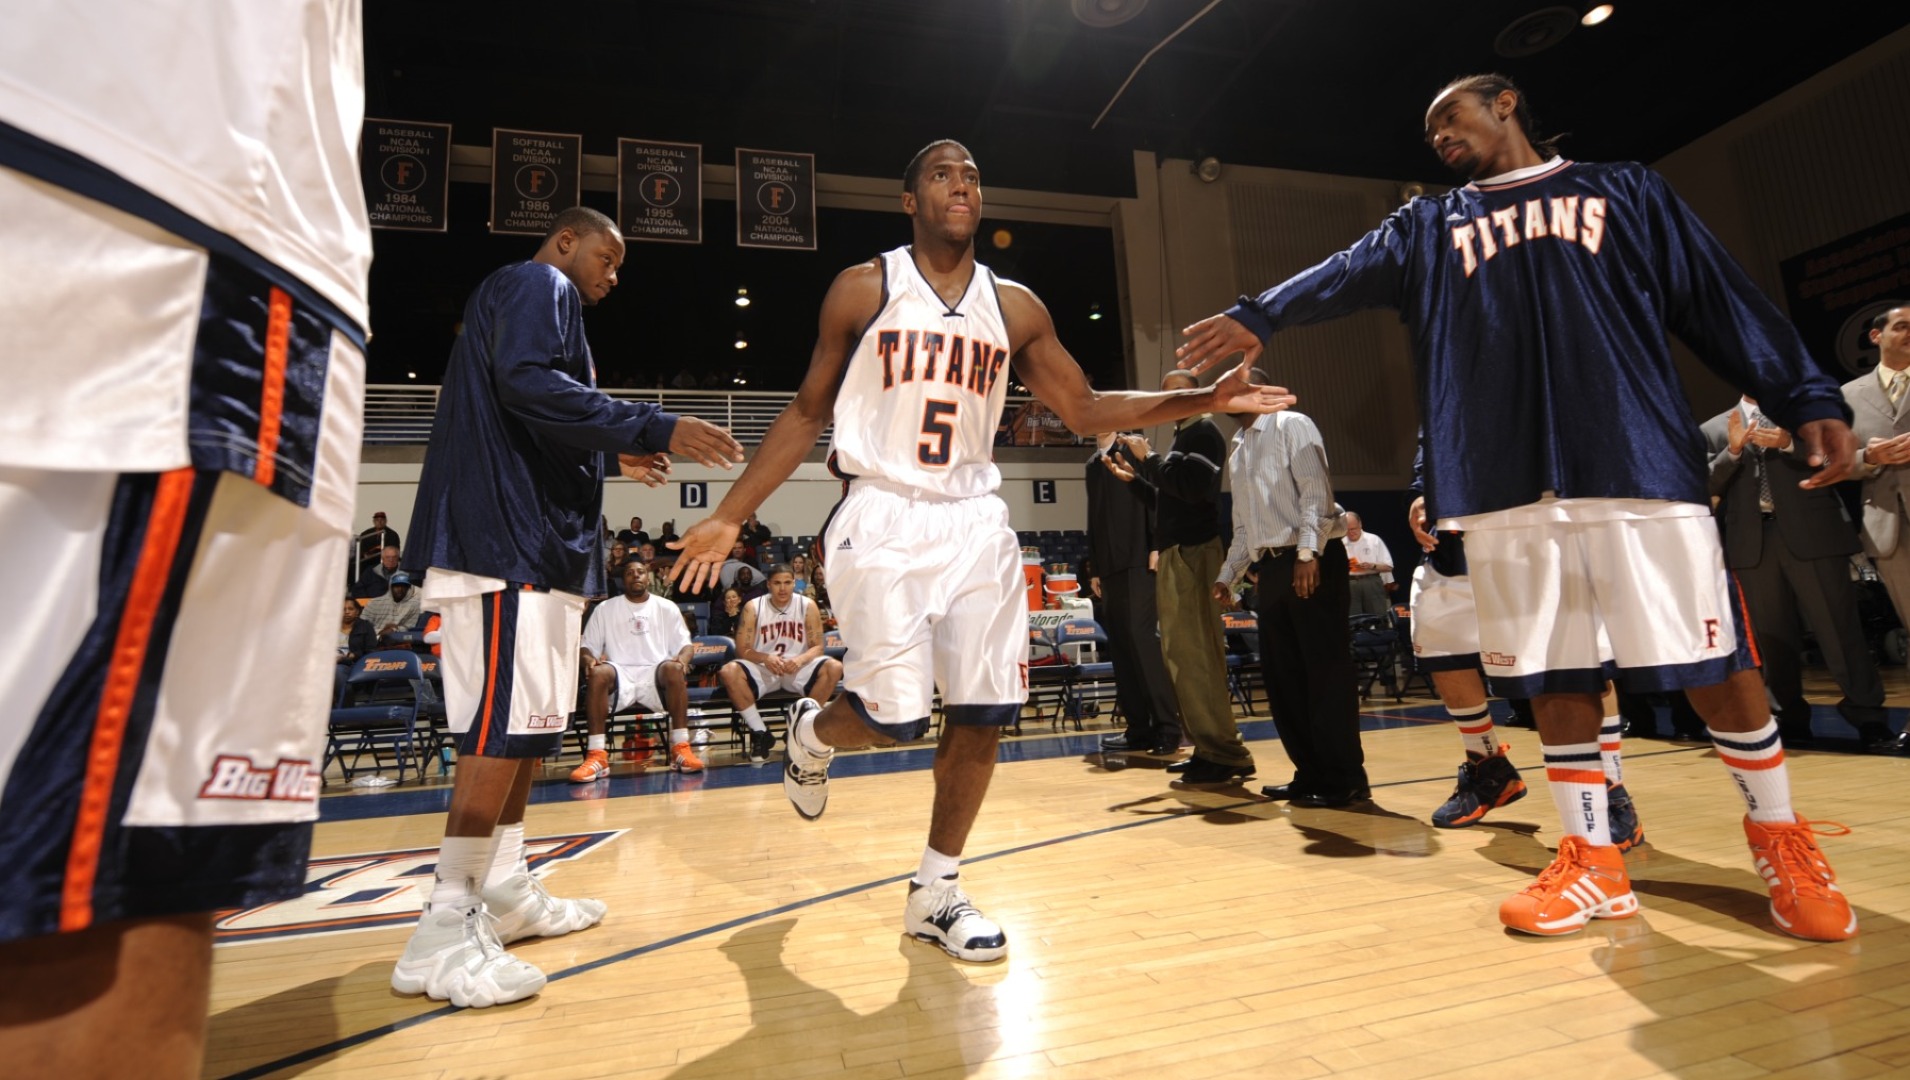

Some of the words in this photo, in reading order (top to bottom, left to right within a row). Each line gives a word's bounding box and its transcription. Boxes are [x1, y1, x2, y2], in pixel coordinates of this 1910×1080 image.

[378, 128, 434, 139] BASEBALL
[390, 138, 420, 147] NCAA
[512, 138, 564, 149] SOFTBALL
[379, 145, 424, 154] DIVISION
[523, 148, 552, 157] NCAA
[636, 147, 686, 158] BASEBALL
[512, 154, 555, 164] DIVISION
[646, 157, 674, 165] NCAA
[752, 157, 800, 168] BASEBALL
[397, 162, 413, 185] F
[637, 164, 678, 172] DIVISION
[763, 166, 788, 174] NCAA
[530, 170, 546, 192] F
[754, 172, 793, 182] DIVISION
[654, 179, 669, 200] F
[385, 193, 416, 204] 1984
[770, 187, 784, 208] F
[376, 203, 428, 214] NATIONAL
[520, 200, 550, 211] 1986
[370, 212, 432, 224] CHAMPIONS
[645, 208, 674, 218] 1995
[505, 219, 551, 229] CHAMPIO
[636, 217, 684, 228] NATIONAL
[762, 215, 790, 225] 2004
[631, 226, 688, 236] CHAMPIONS
[754, 225, 799, 234] NATIONAL
[750, 232, 804, 243] CHAMPIONS
[1451, 195, 1607, 279] TITANS
[877, 329, 1008, 399] TITANS
[917, 397, 960, 467] 5
[686, 484, 701, 506] D
[1039, 481, 1051, 502] E
[1028, 613, 1074, 627] atorade
[761, 620, 804, 645] TITANS
[1702, 618, 1720, 649] F
[1581, 791, 1595, 833] CSUF
